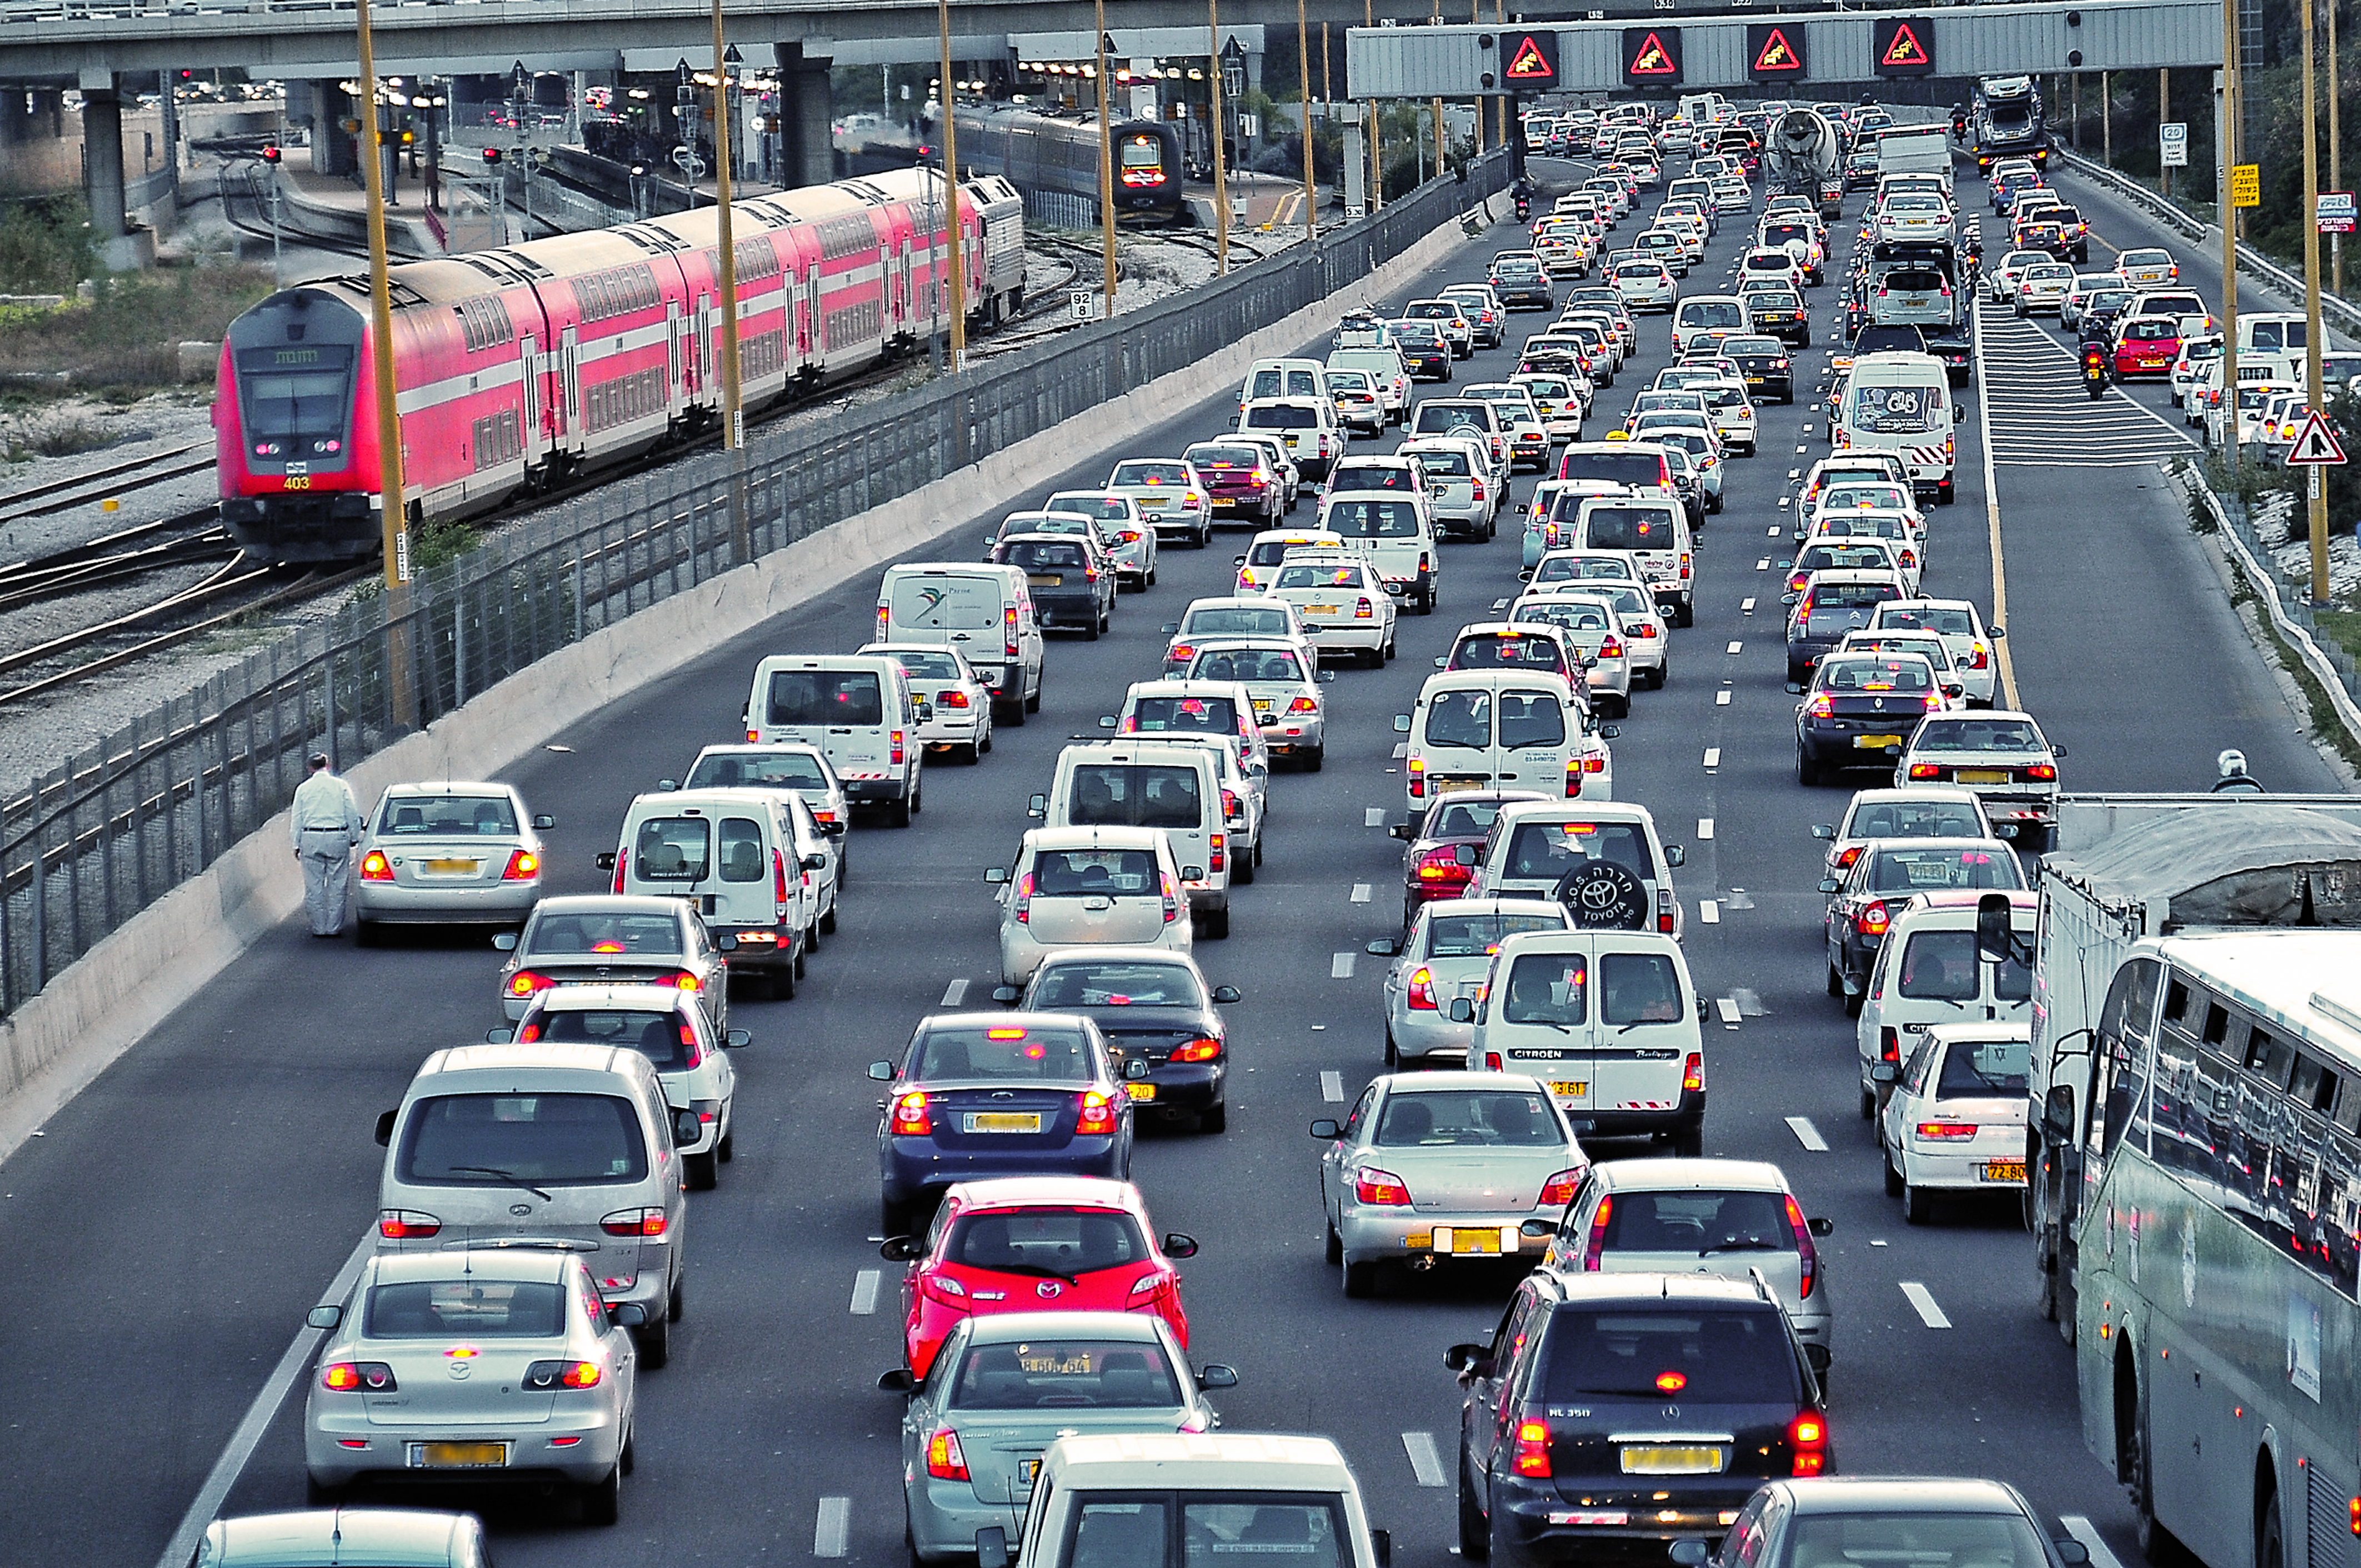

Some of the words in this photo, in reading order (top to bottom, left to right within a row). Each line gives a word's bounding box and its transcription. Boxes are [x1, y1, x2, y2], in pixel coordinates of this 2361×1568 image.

[2167, 128, 2180, 137] 20
[1073, 293, 1090, 304] 92
[1078, 305, 1086, 315] 8
[283, 477, 310, 490] 403
[1593, 867, 1633, 893] חדרה
[1584, 901, 1627, 921] TOYOTA
